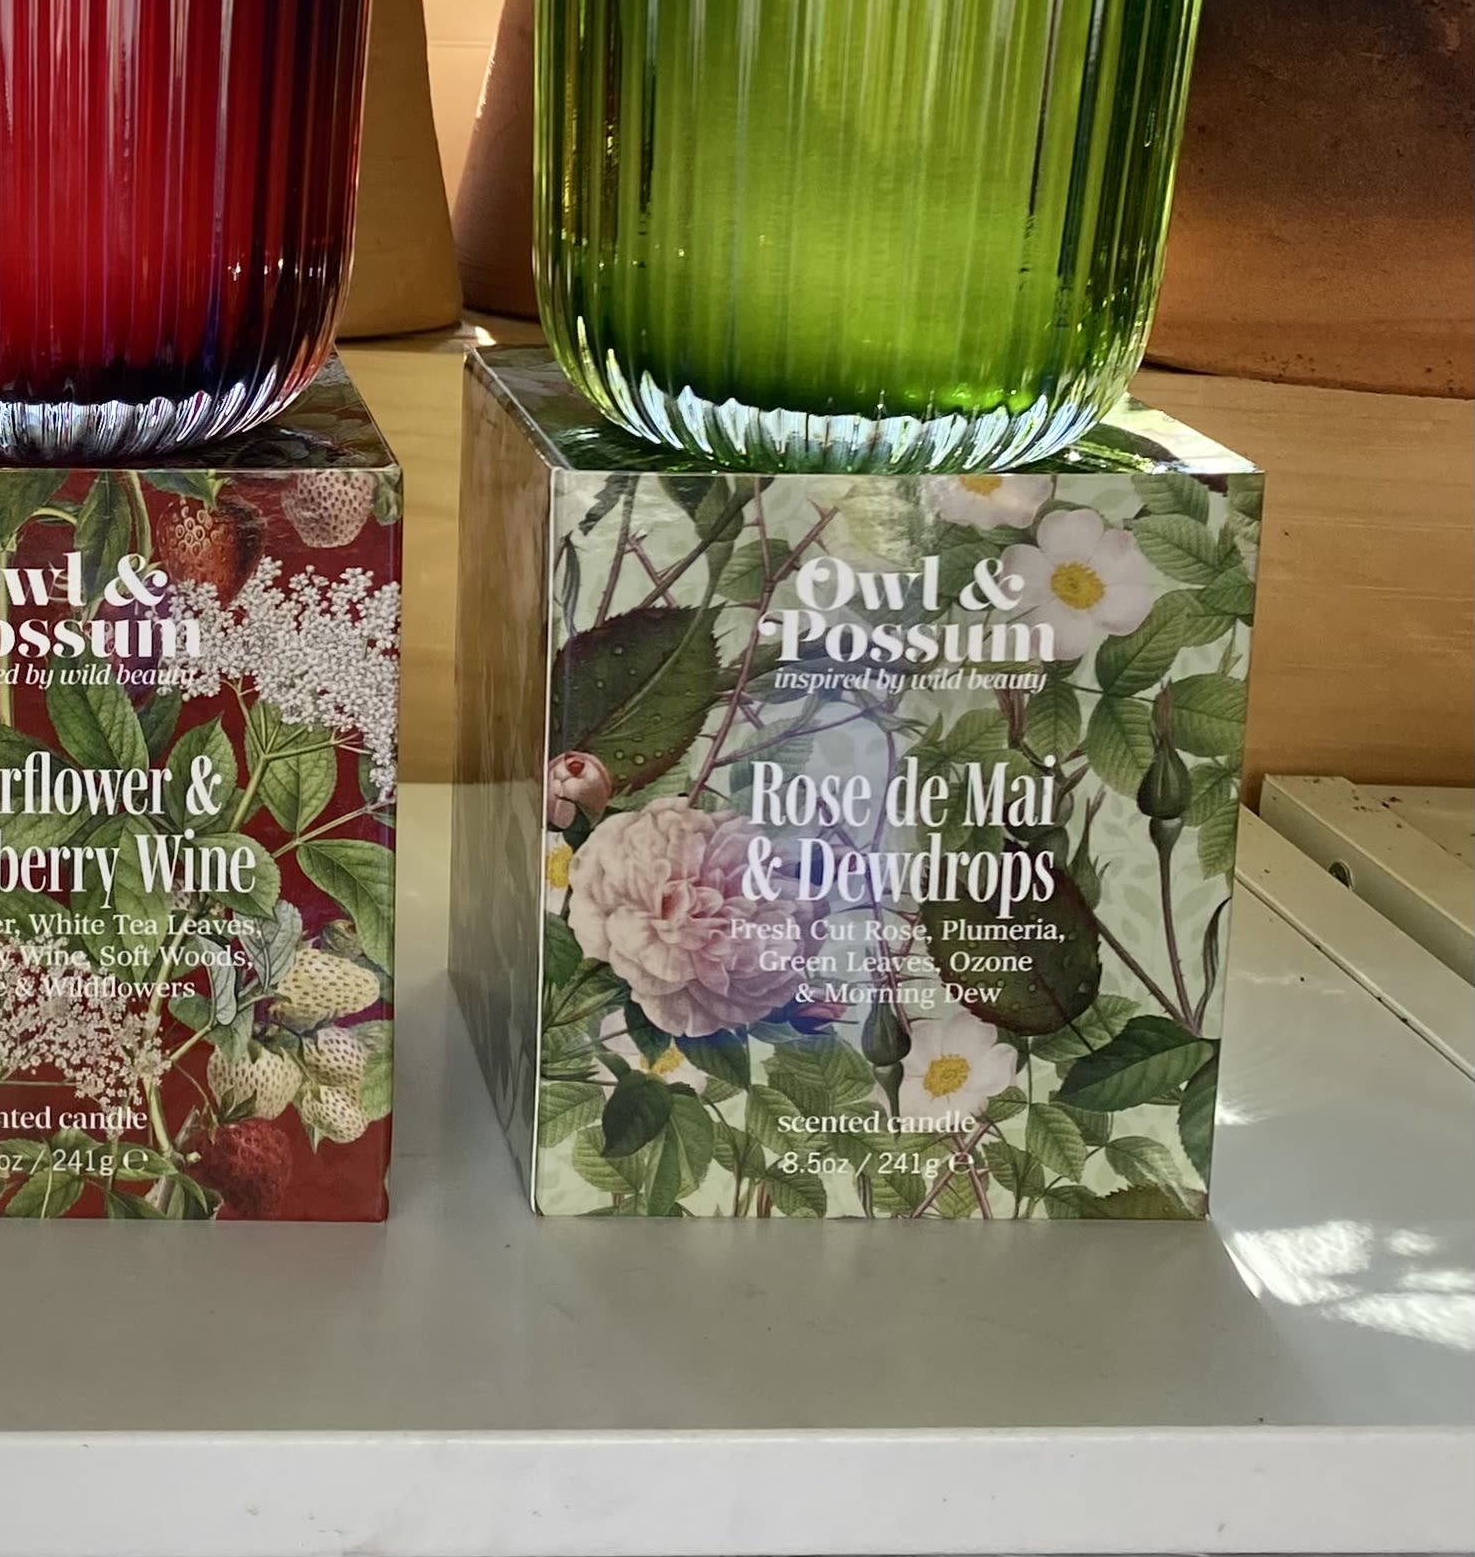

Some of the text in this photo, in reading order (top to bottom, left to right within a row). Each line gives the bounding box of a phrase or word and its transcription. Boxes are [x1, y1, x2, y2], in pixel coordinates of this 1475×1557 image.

[104, 553, 170, 606] &
[795, 556, 1024, 611] Owl &
[758, 609, 1055, 662] Possum
[25, 662, 54, 690] by
[59, 662, 110, 686] wild
[116, 662, 196, 690] beauty
[774, 668, 1047, 696] inspired by wild beauty
[186, 754, 222, 815] &
[751, 755, 1056, 828] Rose de Mai
[134, 827, 257, 893] Wine
[741, 832, 1056, 919] & Dewdrops
[28, 914, 106, 936] White
[113, 914, 159, 935] Tea
[166, 914, 262, 940] Leaves,
[730, 917, 1066, 947] Fresh Cut Rose, Plumeria,
[20, 945, 92, 971] Wine,
[99, 945, 153, 967] Soft
[160, 945, 254, 971] Woods,
[759, 951, 1033, 978] Green Leaves, Ozone
[14, 976, 35, 998] &
[42, 975, 196, 999] Wildflowers
[795, 982, 1001, 1012] & Morning Dew
[58, 1106, 148, 1130] candle
[777, 1110, 975, 1134] scented candle
[30, 1147, 45, 1175] /
[52, 1148, 114, 1176] 241g
[781, 1151, 850, 1175] 8.5oz
[856, 1151, 870, 1177] /
[877, 1151, 939, 1179] 241g
